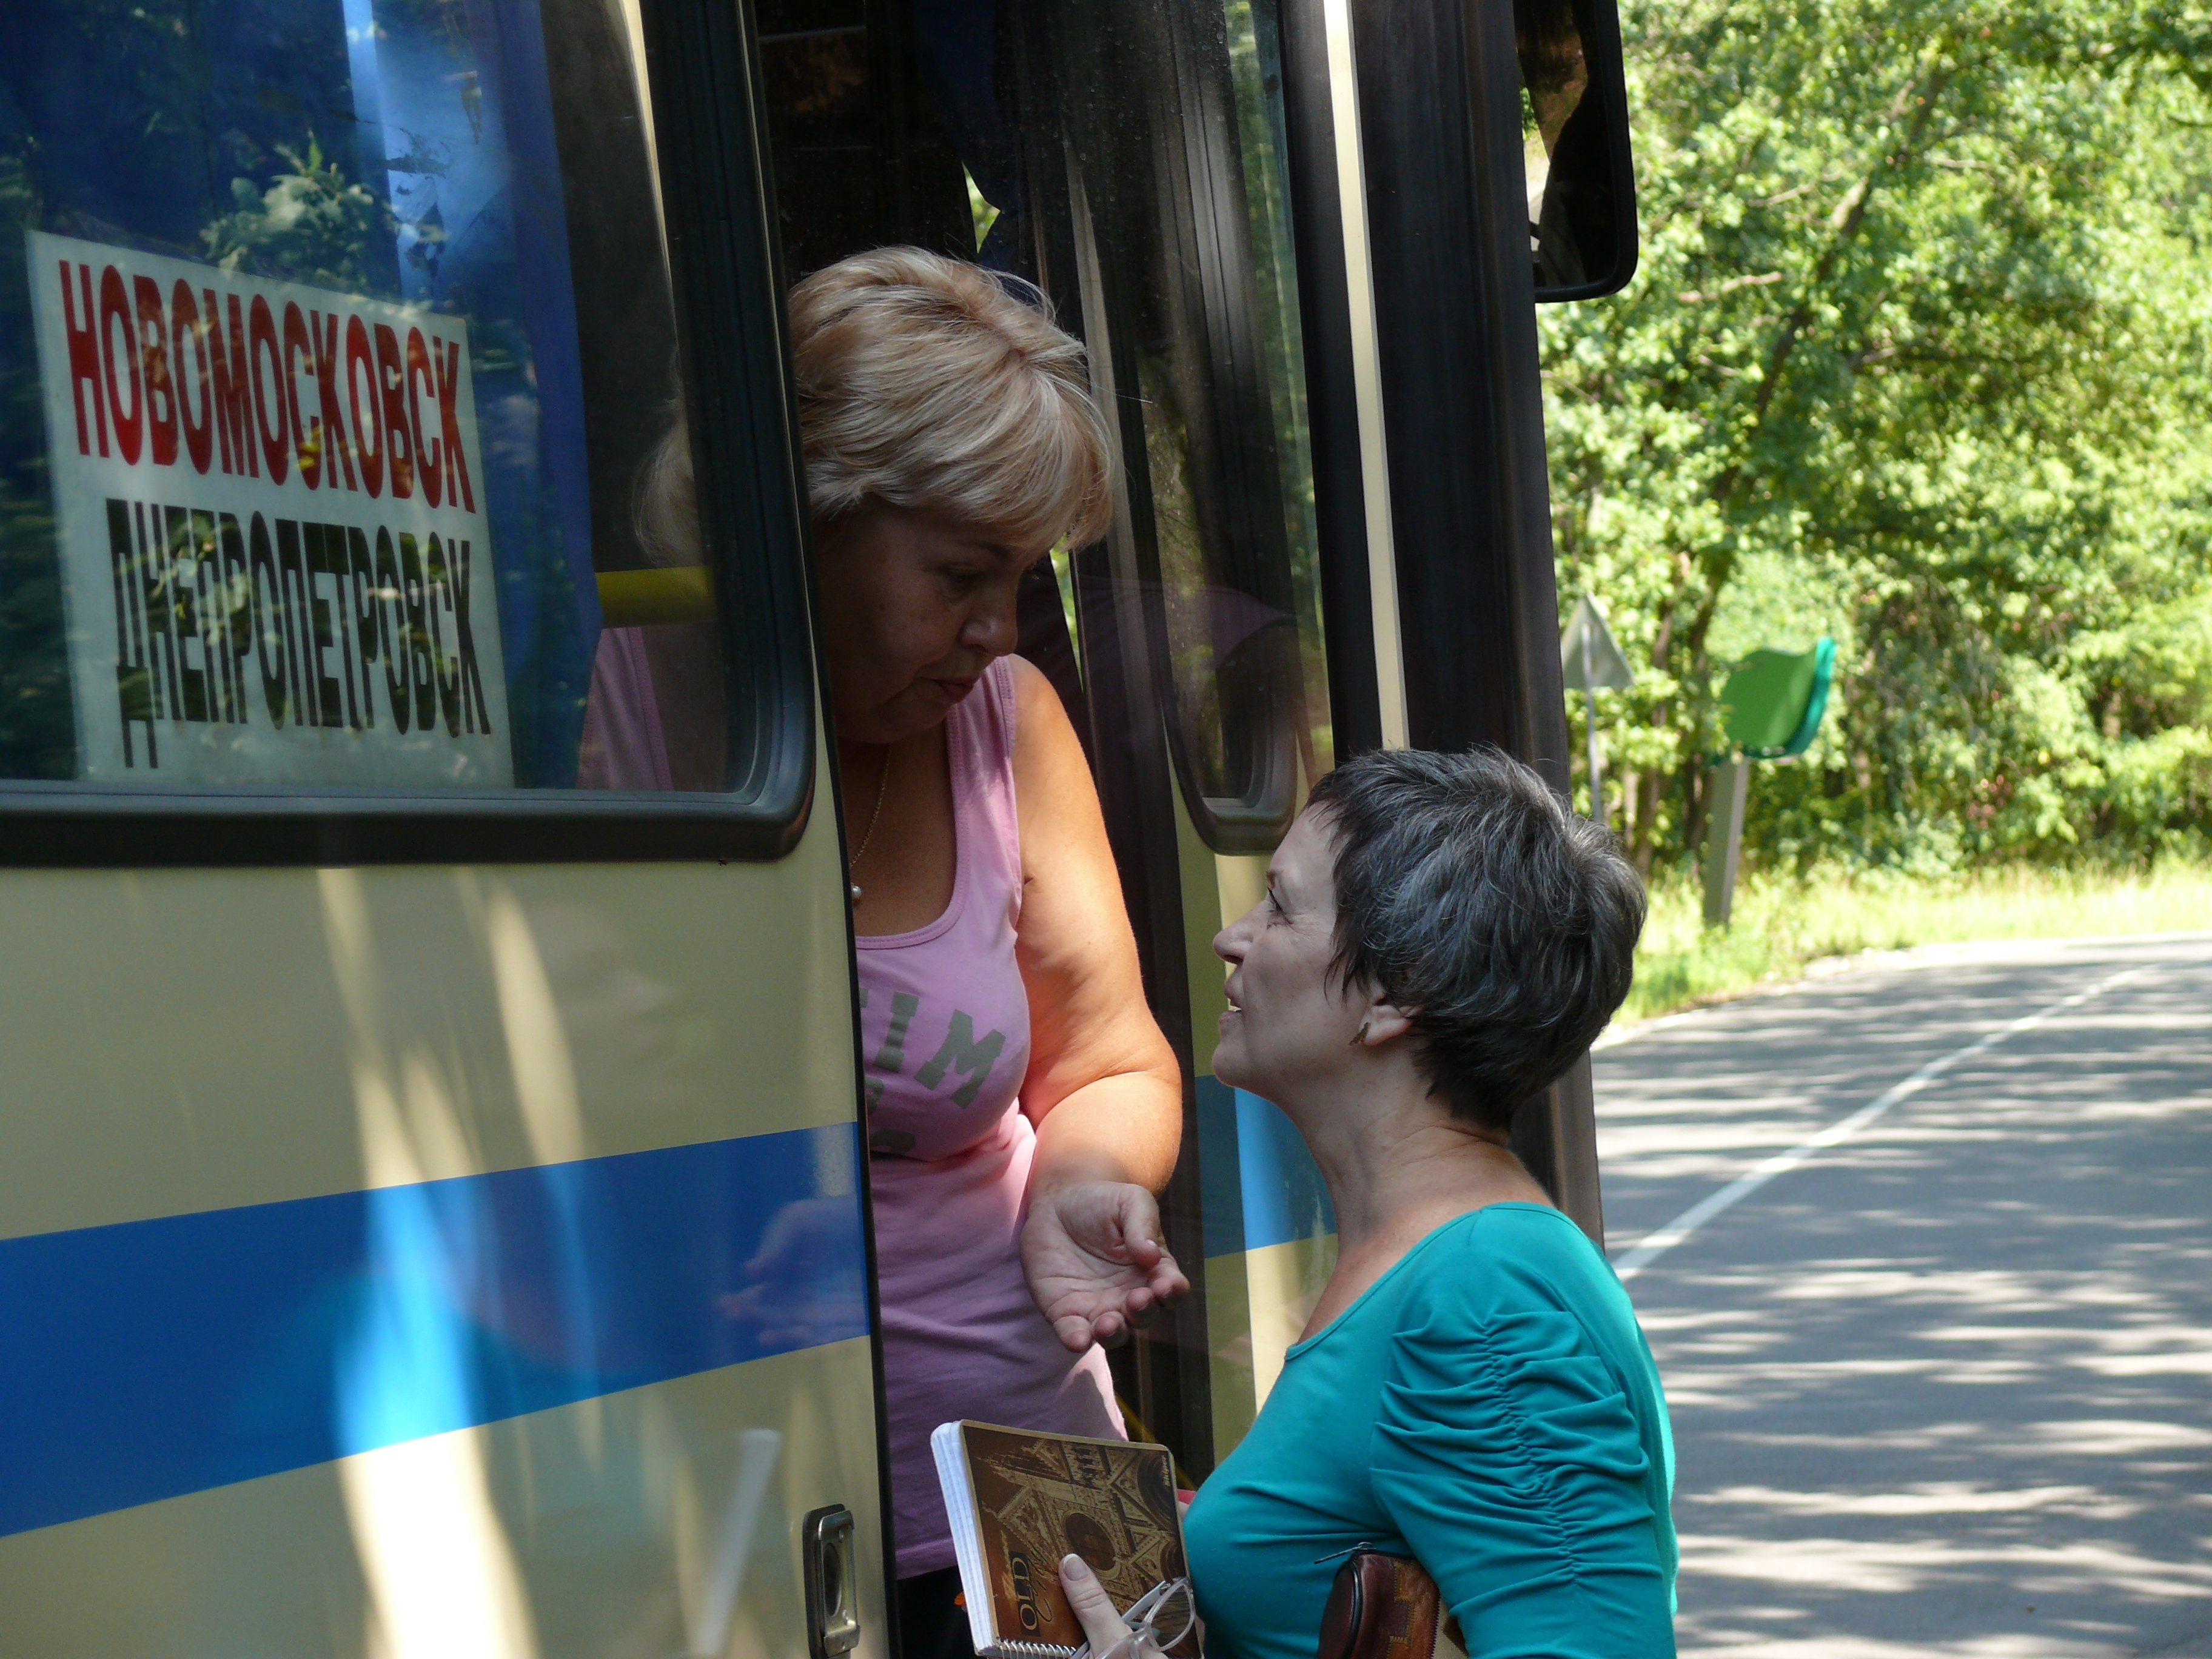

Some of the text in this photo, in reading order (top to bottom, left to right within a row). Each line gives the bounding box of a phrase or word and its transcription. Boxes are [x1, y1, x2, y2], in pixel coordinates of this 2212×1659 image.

[59, 260, 475, 513] НОВОМОСКОВСК
[106, 498, 490, 768] ДНЕПРОПЕТРОВСК
[1012, 1557, 1037, 1630] OLD
